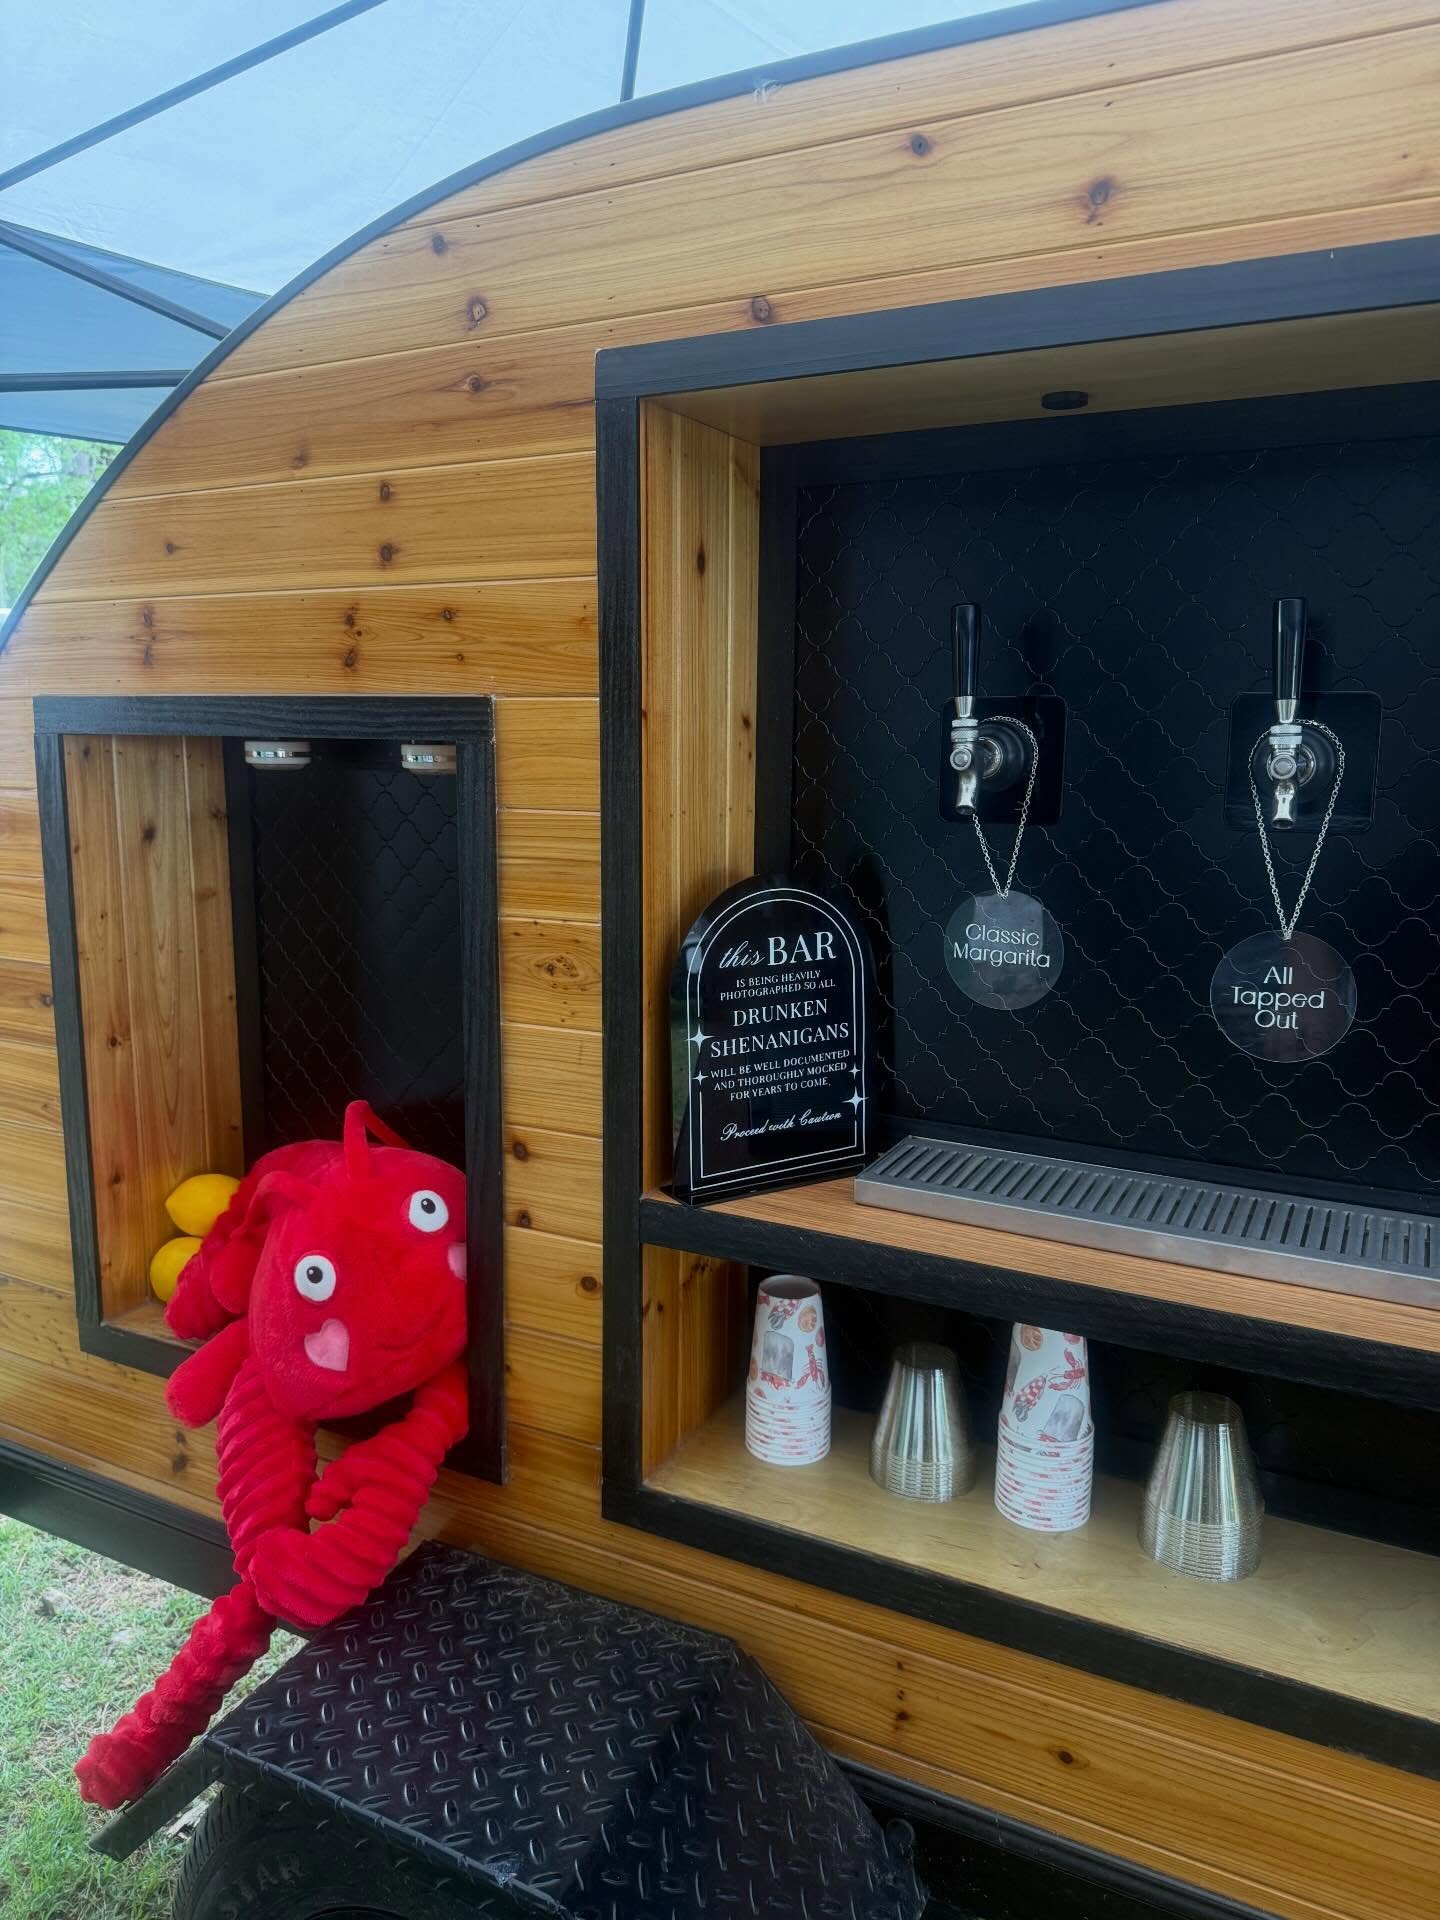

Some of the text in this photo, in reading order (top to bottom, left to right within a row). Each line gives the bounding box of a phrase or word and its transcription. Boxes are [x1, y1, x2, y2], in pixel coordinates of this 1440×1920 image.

[965, 923, 1040, 946] Classic
[718, 931, 837, 969] this BAR
[953, 941, 1050, 968] Margarita
[736, 969, 820, 988] IS BEING HEAVILY
[1263, 966, 1293, 985] All
[720, 979, 836, 1001] PHOTOGRAPHED SO ALL
[1231, 986, 1325, 1010] Tapped
[733, 998, 828, 1027] DRUNKEN
[1254, 1010, 1299, 1030] Out
[710, 1023, 849, 1058] SHENANIGANS
[710, 1049, 850, 1079] WILL BE WELL DOCUMENTED
[713, 1062, 847, 1091] AND THOROUGHLY MOCKED
[730, 1090, 749, 1101] FOR
[752, 1086, 782, 1098] YEARS
[785, 1082, 798, 1092] TO
[720, 1109, 841, 1142] Proceed with Caution
